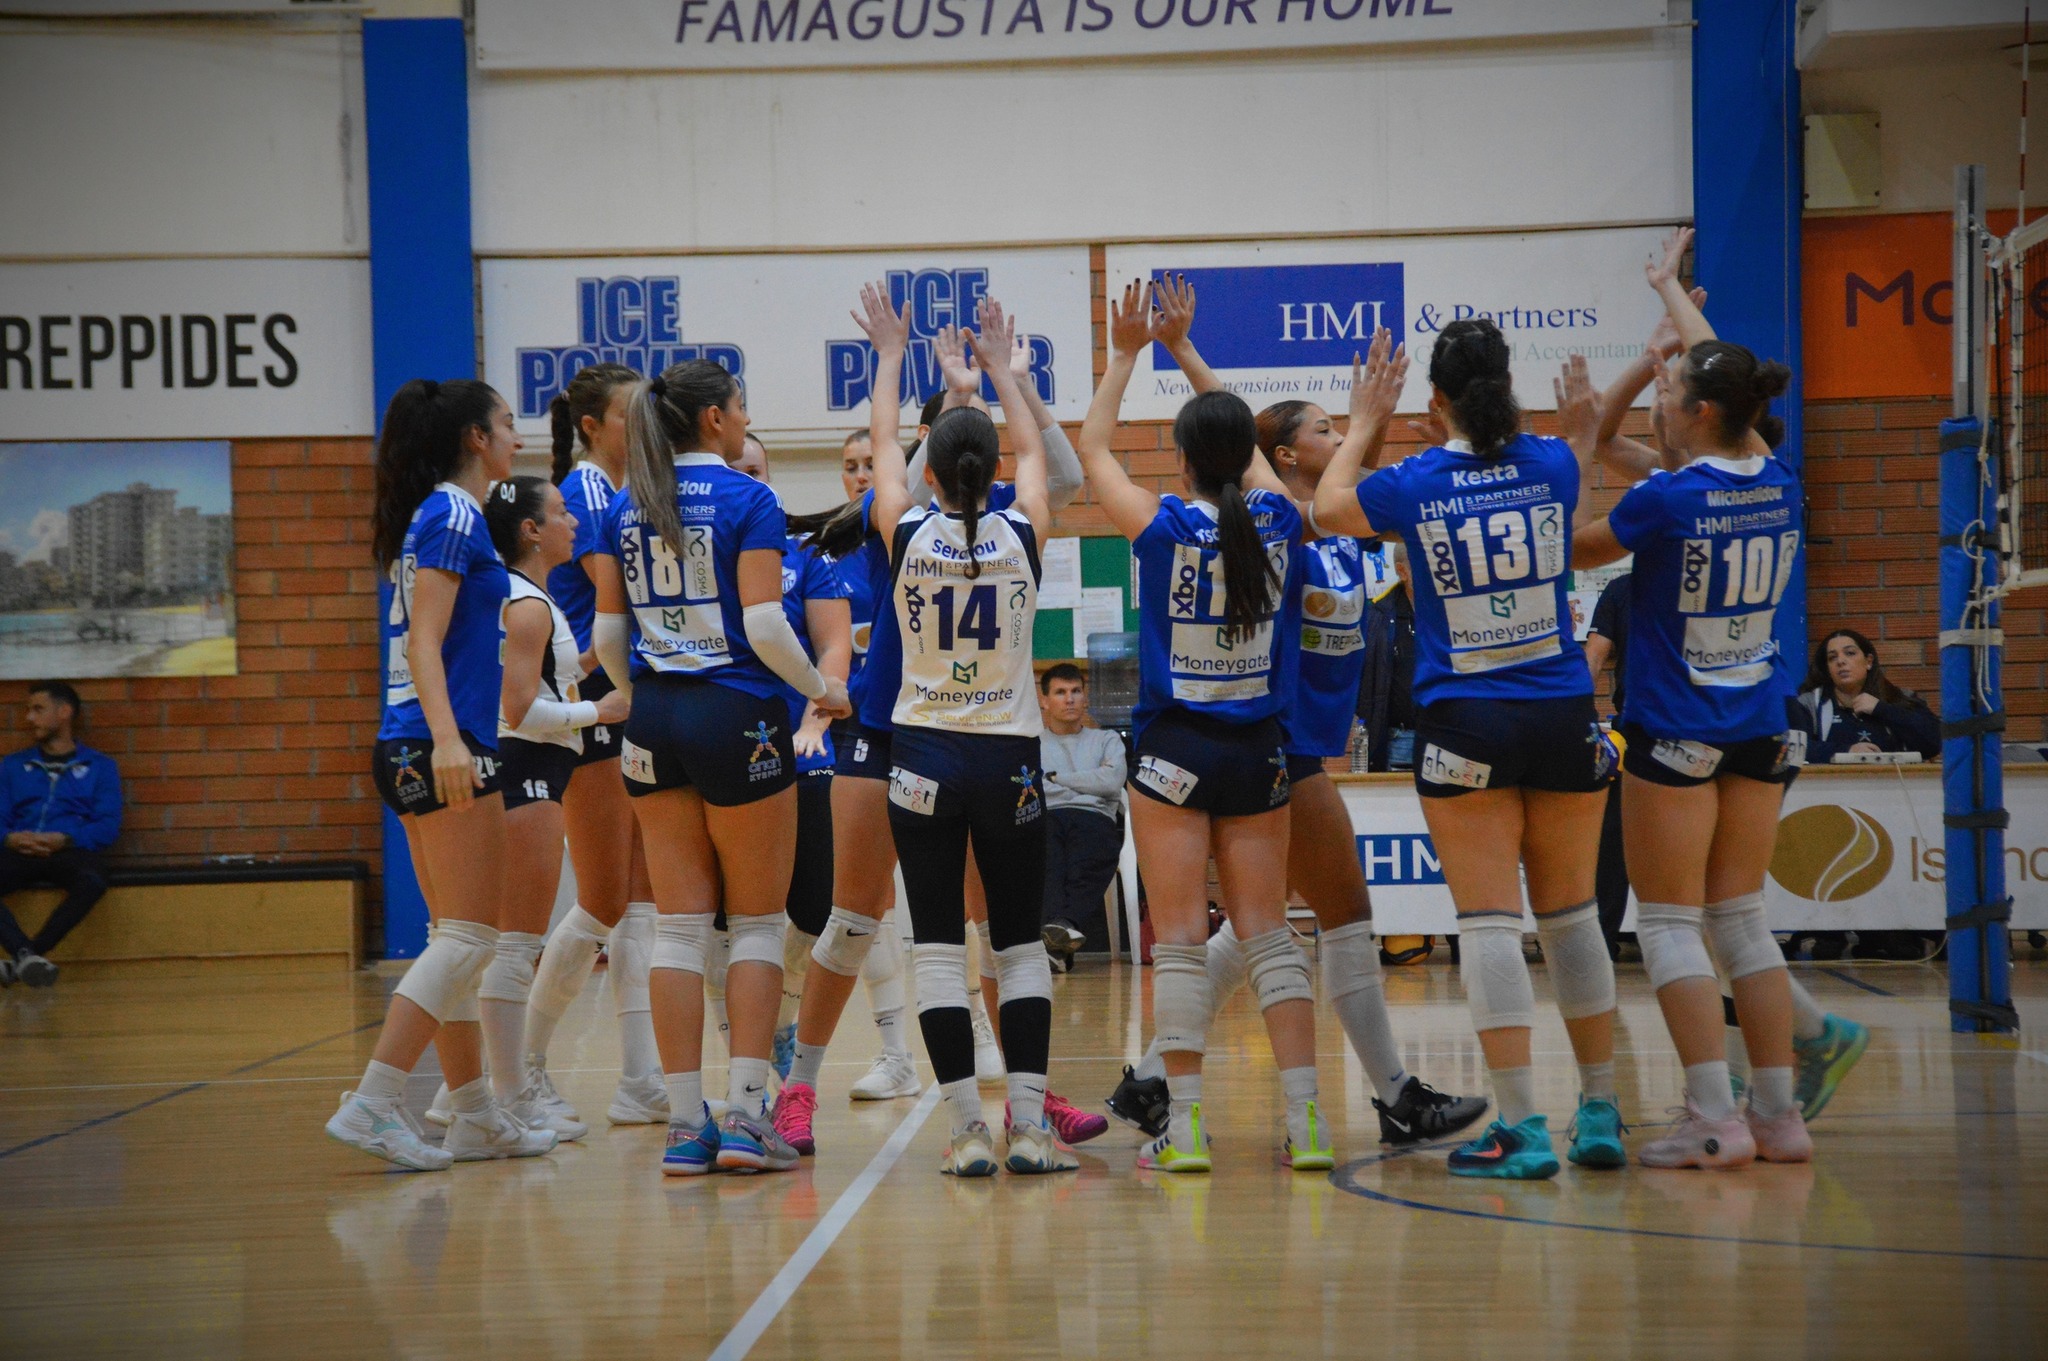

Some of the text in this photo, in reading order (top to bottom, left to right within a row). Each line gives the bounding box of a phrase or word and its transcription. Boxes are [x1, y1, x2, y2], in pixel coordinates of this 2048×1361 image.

[675, 0, 1044, 43] FAMAGUSTA
[1065, 0, 1113, 32] IS
[577, 276, 682, 346] ICE
[886, 268, 988, 338] ICE
[1279, 301, 1385, 342] HMI
[1154, 378, 1191, 396] New
[1307, 376, 1323, 391] in
[1452, 464, 1519, 487] Kesta
[1420, 498, 1465, 520] HMI
[1475, 483, 1551, 504] PARTNERS
[1695, 516, 1732, 535] HMI
[1738, 507, 1790, 524] PARTNERS
[1456, 511, 1531, 587] 13
[648, 535, 682, 597] 8
[906, 557, 942, 577] HMI
[954, 556, 1020, 570] PATNERS
[1723, 536, 1774, 607] 10
[932, 585, 1001, 651] 14
[1453, 616, 1556, 644] Moneygate
[1172, 653, 1269, 674] Moneygate
[915, 684, 1013, 704] Moneygate
[594, 725, 611, 744] 4
[853, 738, 869, 762] 5
[523, 778, 549, 800] 16
